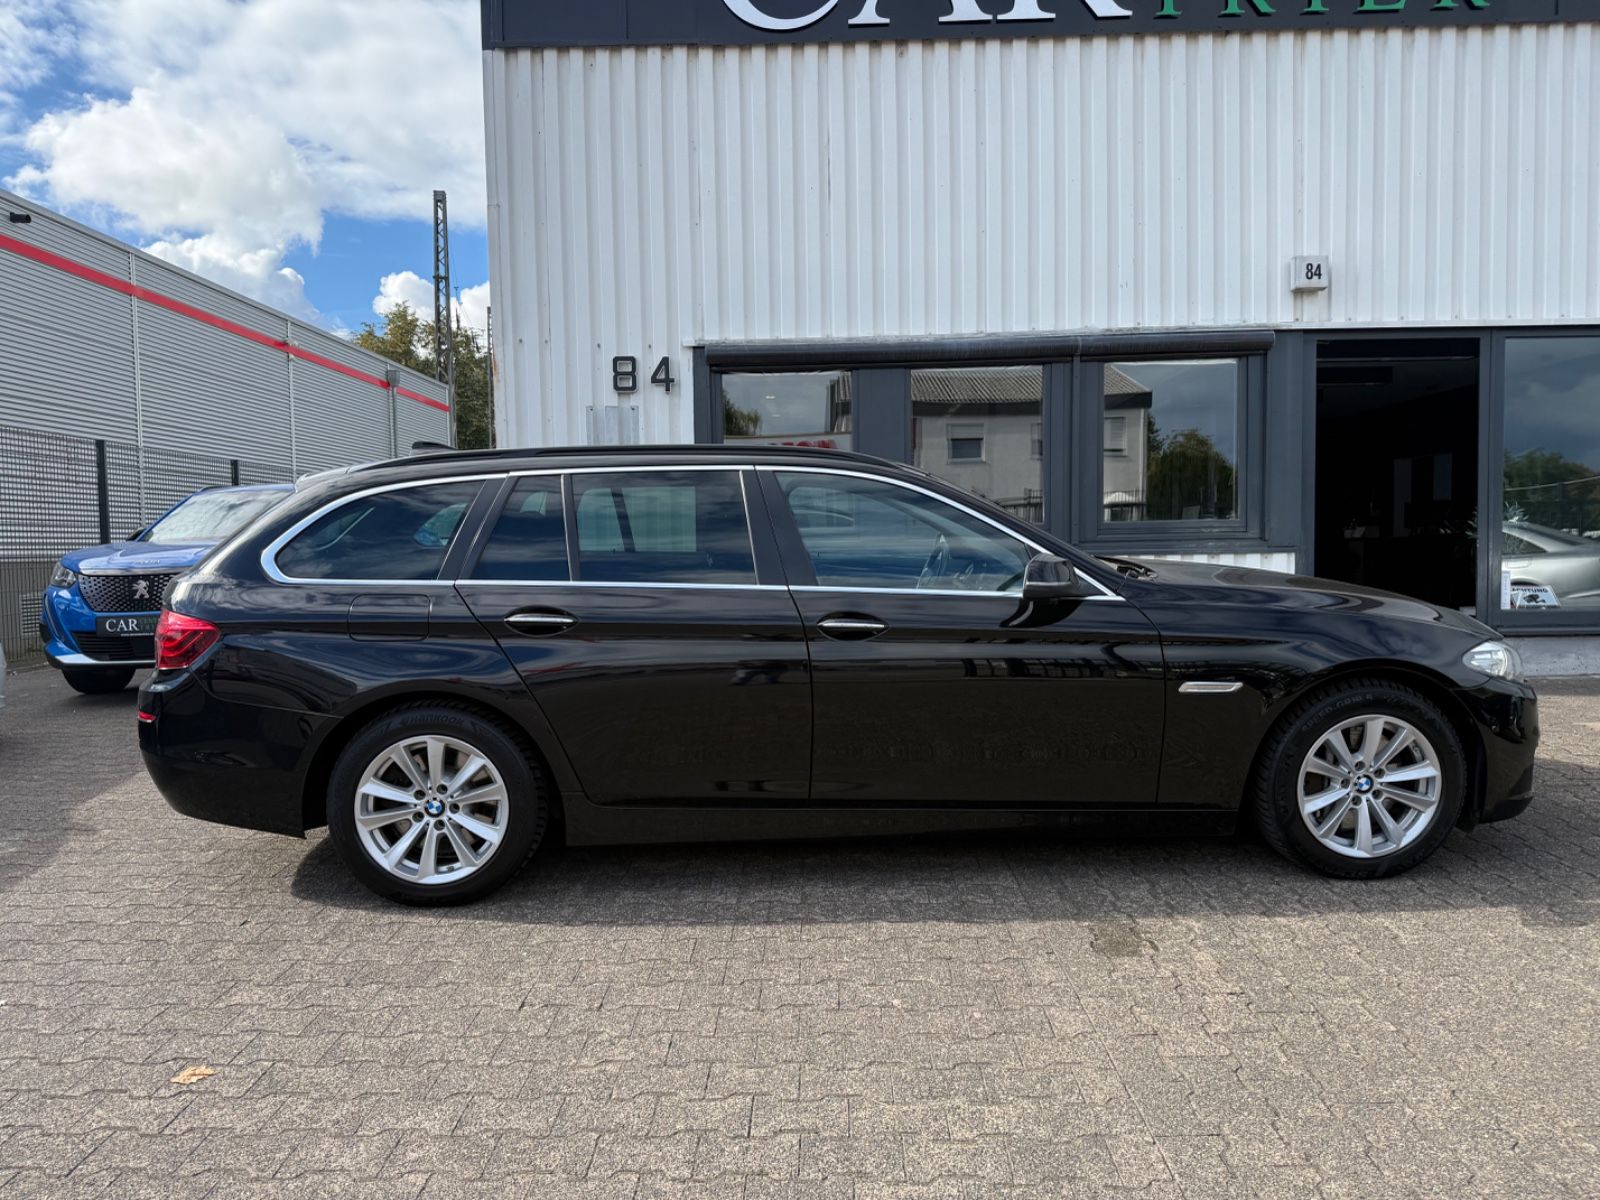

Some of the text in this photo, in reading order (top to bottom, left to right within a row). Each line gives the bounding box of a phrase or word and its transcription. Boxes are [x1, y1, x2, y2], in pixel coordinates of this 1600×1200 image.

[1305, 262, 1323, 280] 84
[612, 355, 676, 392] 84
[105, 618, 140, 633] CAR
